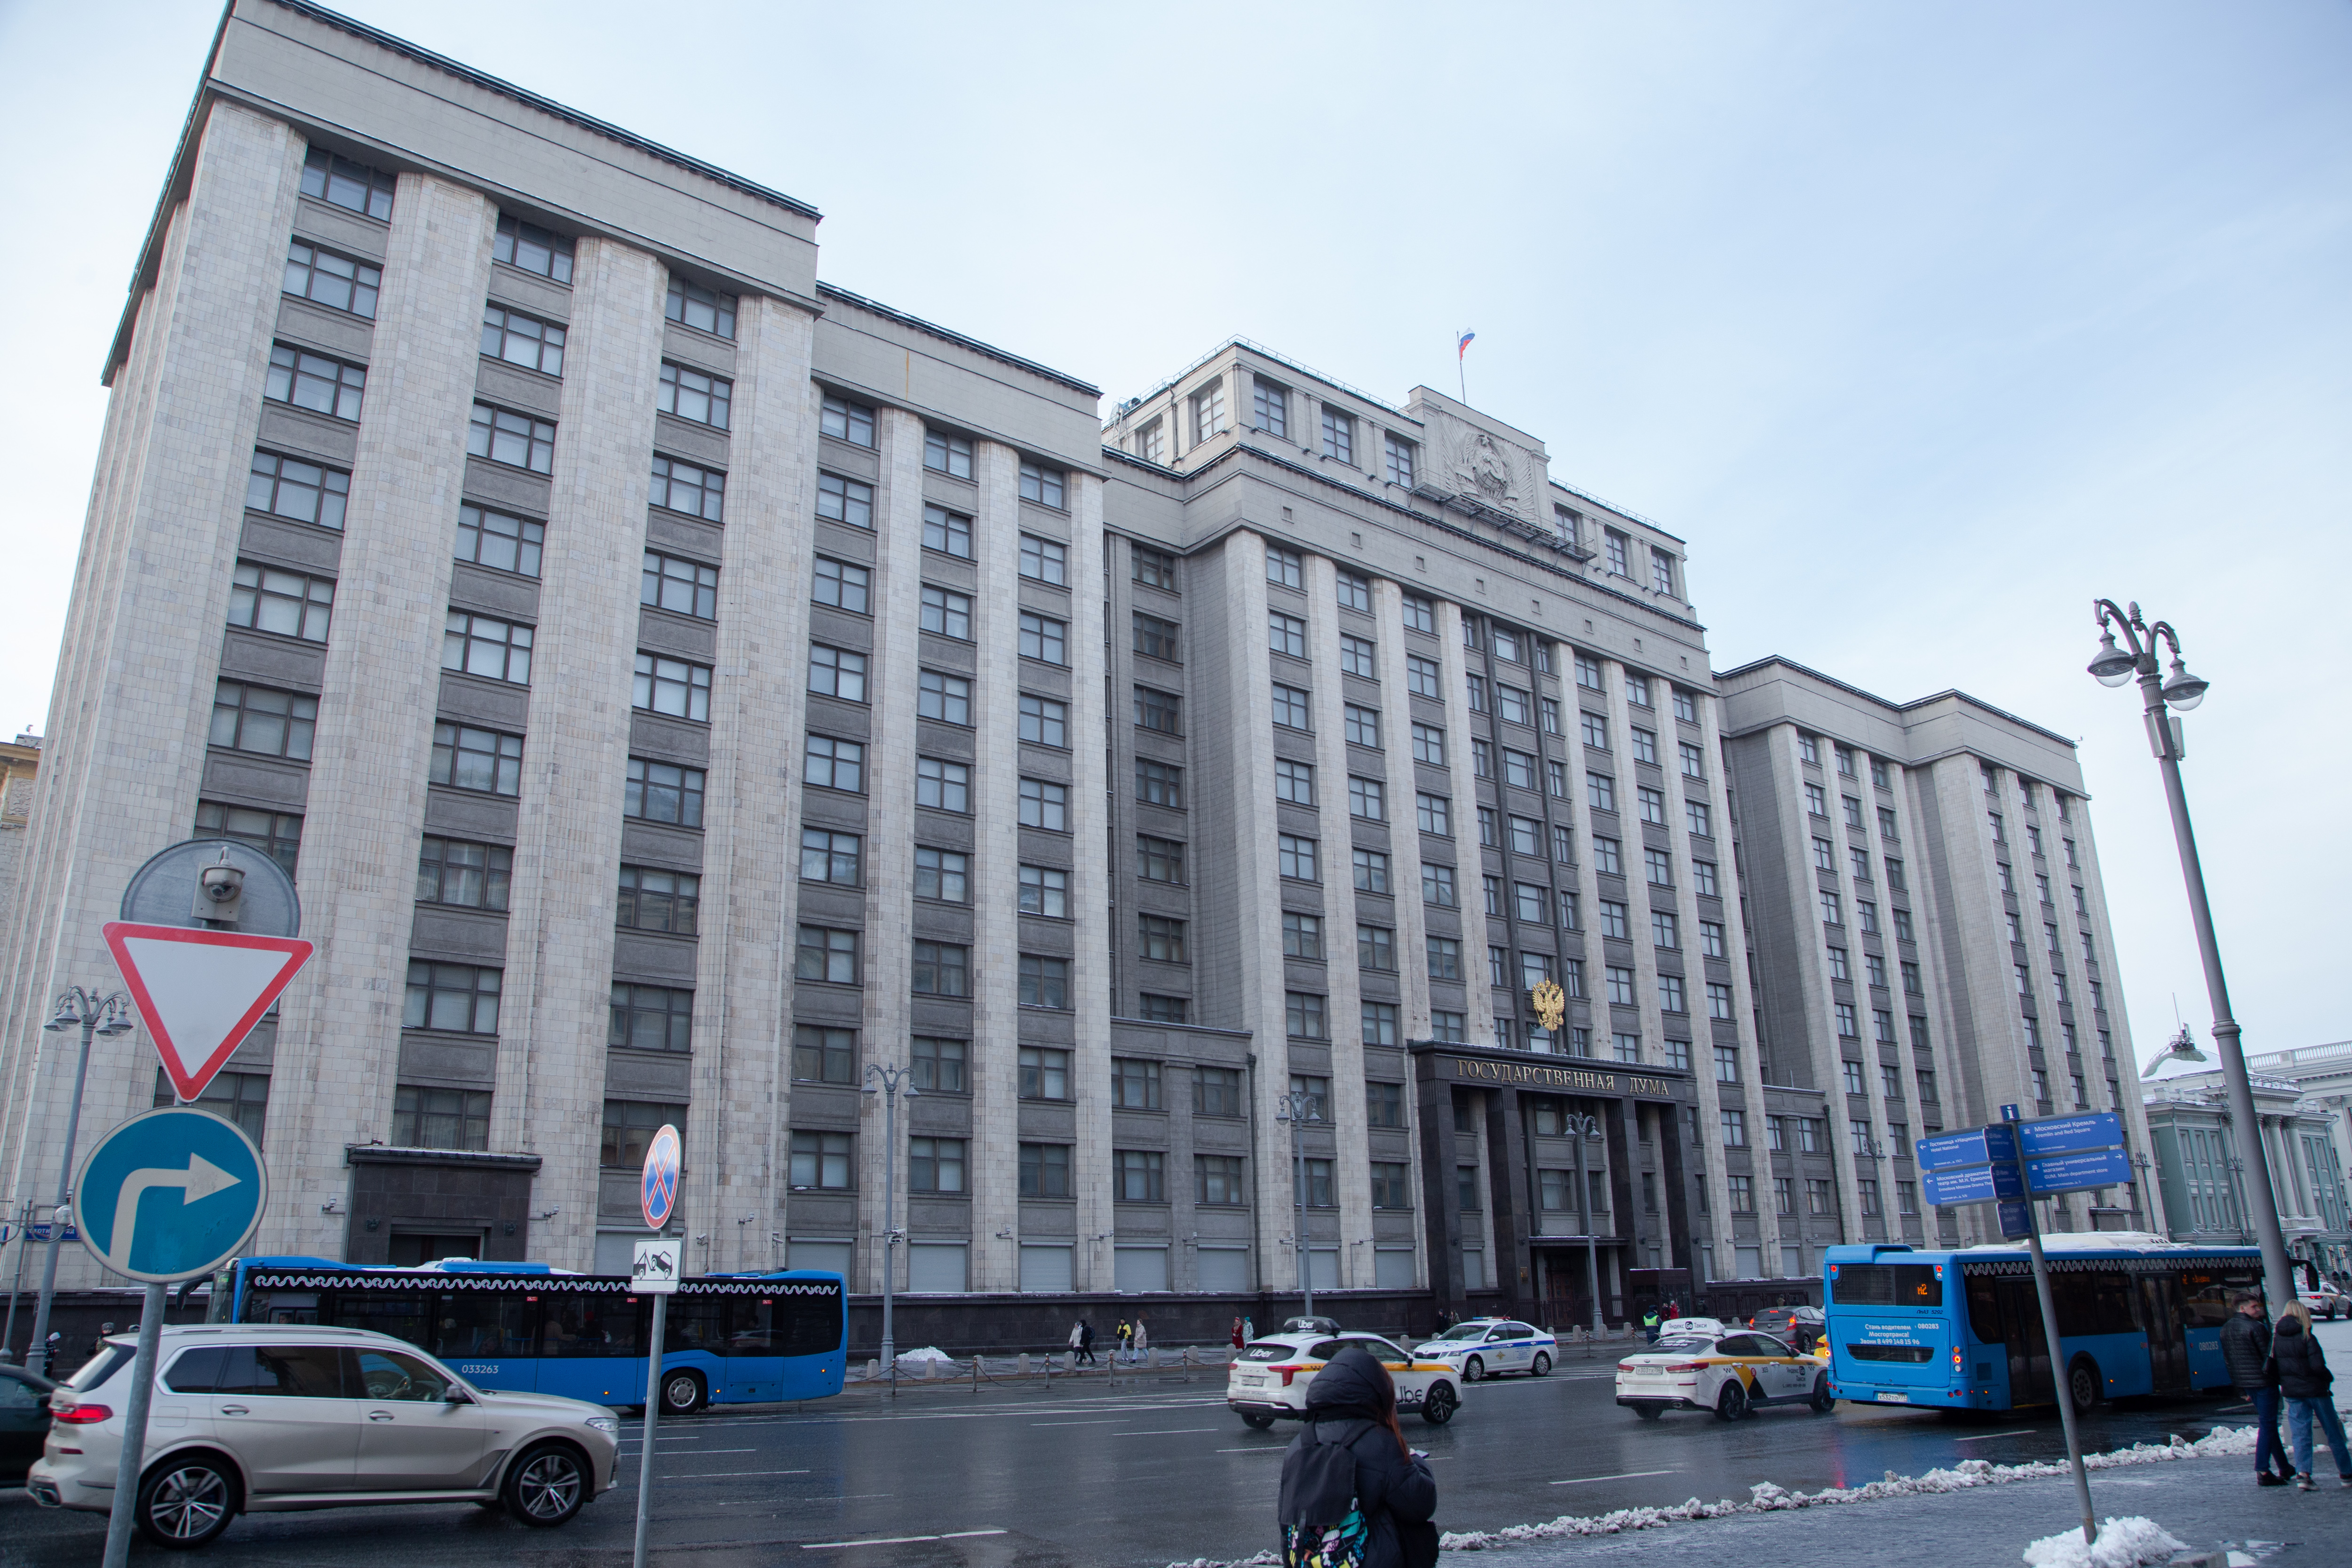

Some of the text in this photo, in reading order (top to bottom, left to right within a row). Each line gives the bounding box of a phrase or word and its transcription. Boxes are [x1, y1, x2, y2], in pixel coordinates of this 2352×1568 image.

[1457, 1060, 1669, 1095] ГОСУДАРСТВЕННАЯ ДУМА
[2034, 1122, 2071, 1132] Московский
[2064, 1155, 2107, 1167] универсальный
[1297, 1319, 1315, 1329] Uber
[2199, 1341, 2219, 1351] 080283
[1249, 1348, 1274, 1358] Uber
[461, 1364, 499, 1374] 033263
